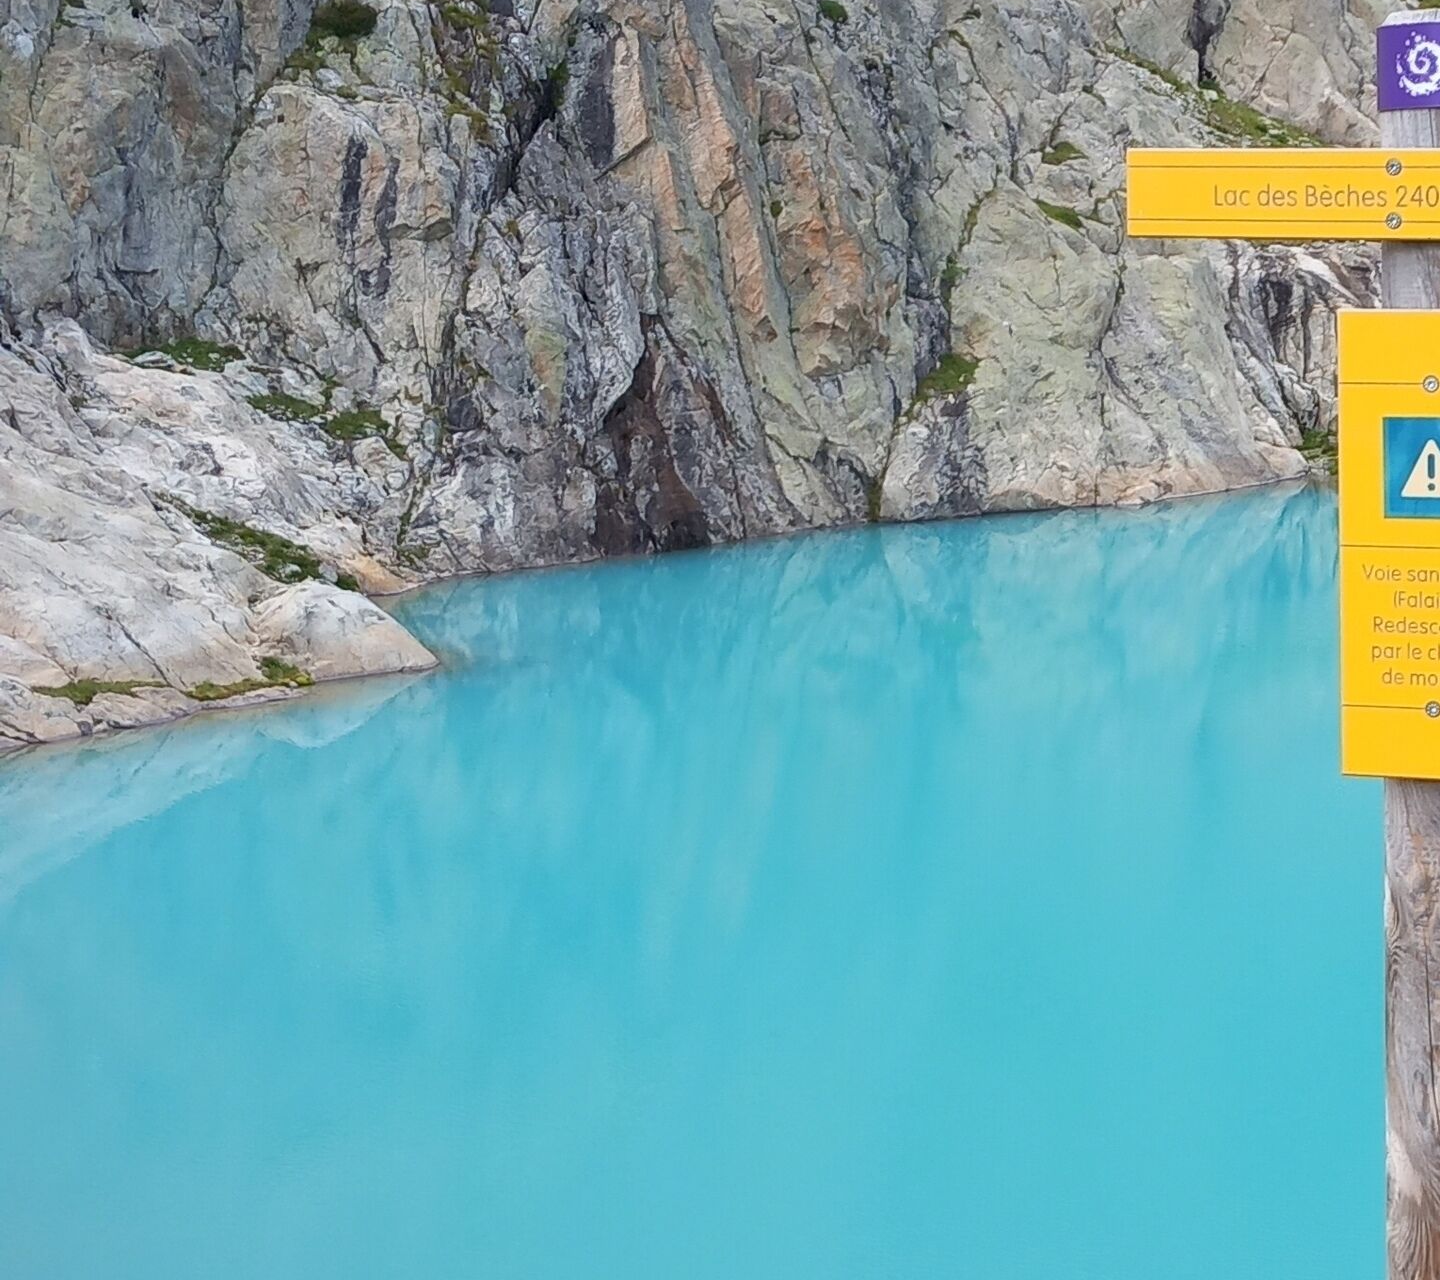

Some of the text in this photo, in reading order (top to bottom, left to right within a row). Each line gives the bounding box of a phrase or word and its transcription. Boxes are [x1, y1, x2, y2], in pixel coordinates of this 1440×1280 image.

[1213, 184, 1251, 208] Lac
[1258, 184, 1298, 208] des
[1305, 183, 1387, 209] Bèches
[1362, 564, 1401, 582] Voie
[1371, 645, 1401, 662] par
[1407, 643, 1422, 660] le
[1382, 668, 1404, 685] de
